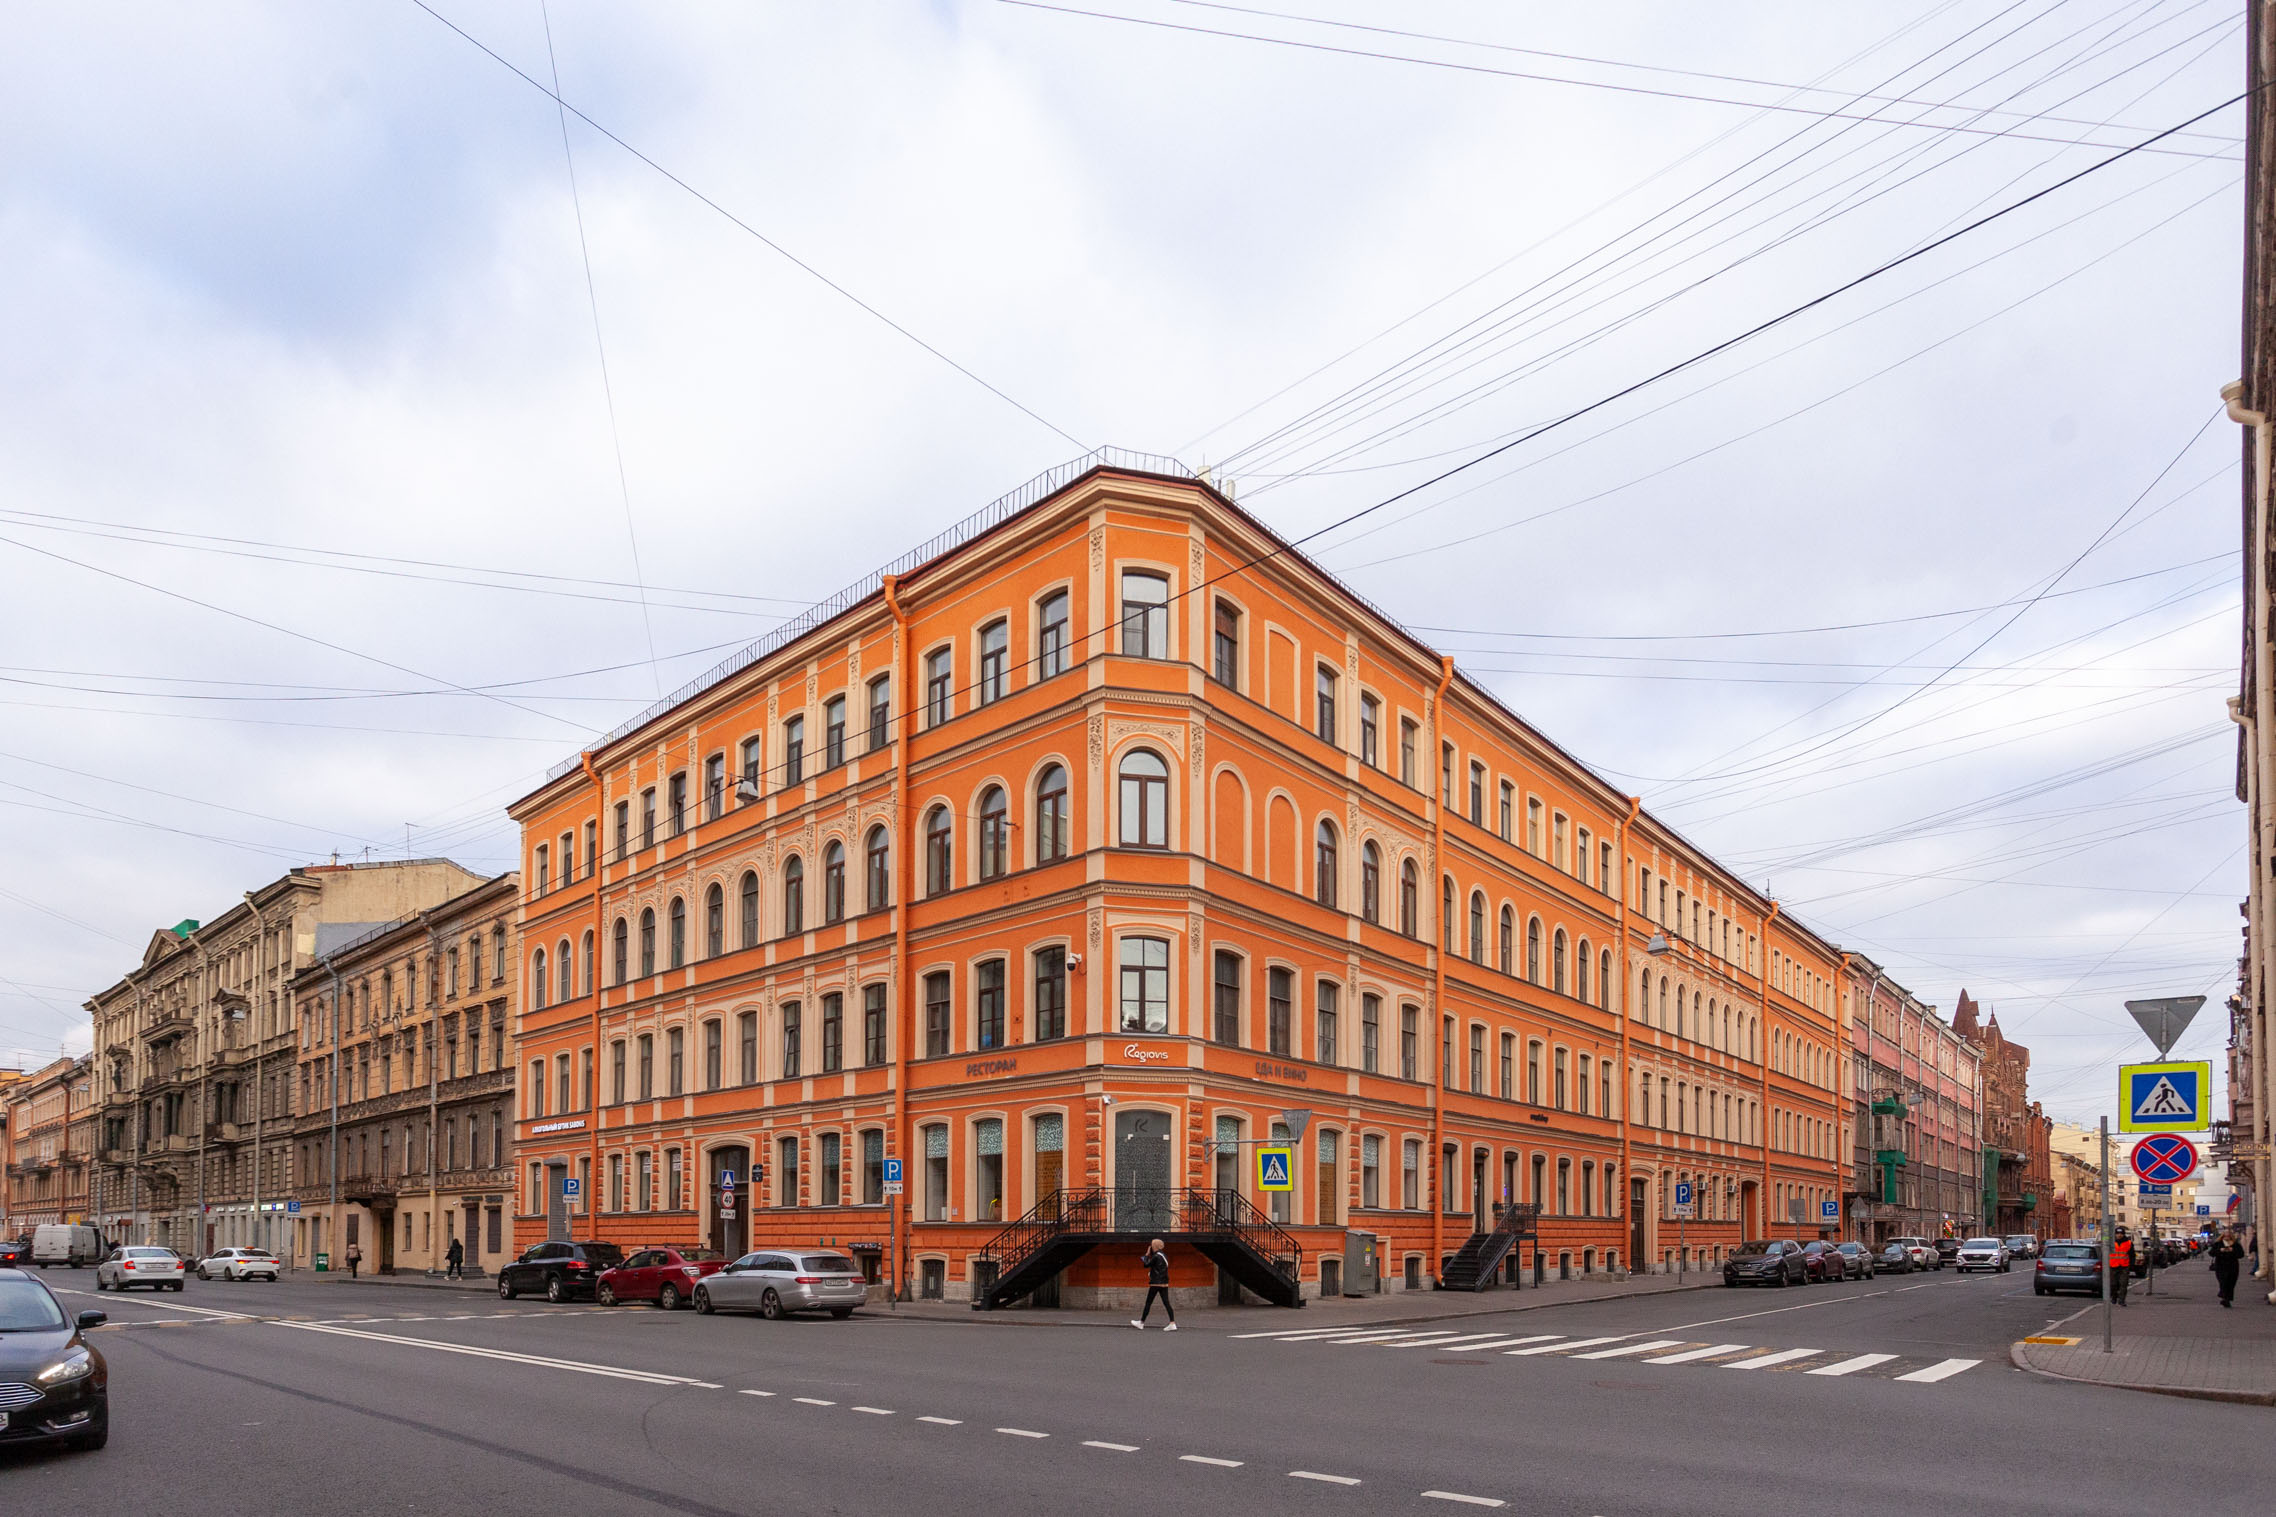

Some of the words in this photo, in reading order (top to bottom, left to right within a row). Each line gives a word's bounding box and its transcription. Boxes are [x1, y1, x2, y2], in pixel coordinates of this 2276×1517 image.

[1124, 1043, 1168, 1062] Regions
[966, 1058, 1017, 1077] РЕСТОРАН
[724, 1195, 732, 1203] 40
